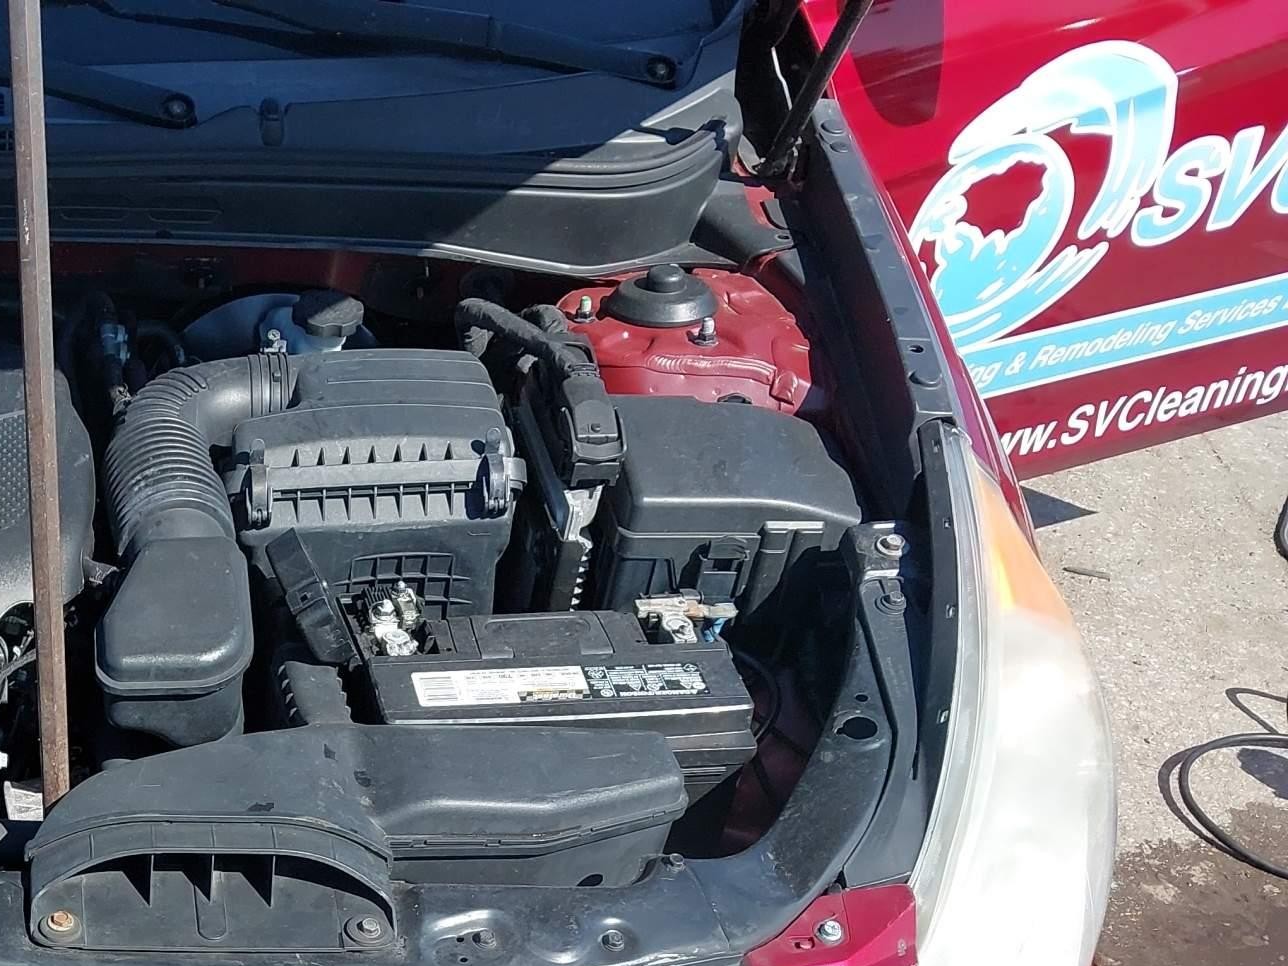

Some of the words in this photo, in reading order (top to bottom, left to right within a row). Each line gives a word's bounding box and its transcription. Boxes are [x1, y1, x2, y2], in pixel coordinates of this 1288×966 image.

[1131, 123, 1288, 247] SV
[1004, 351, 1027, 376] &
[1029, 319, 1178, 370] Remodeling
[1177, 294, 1283, 335] Services
